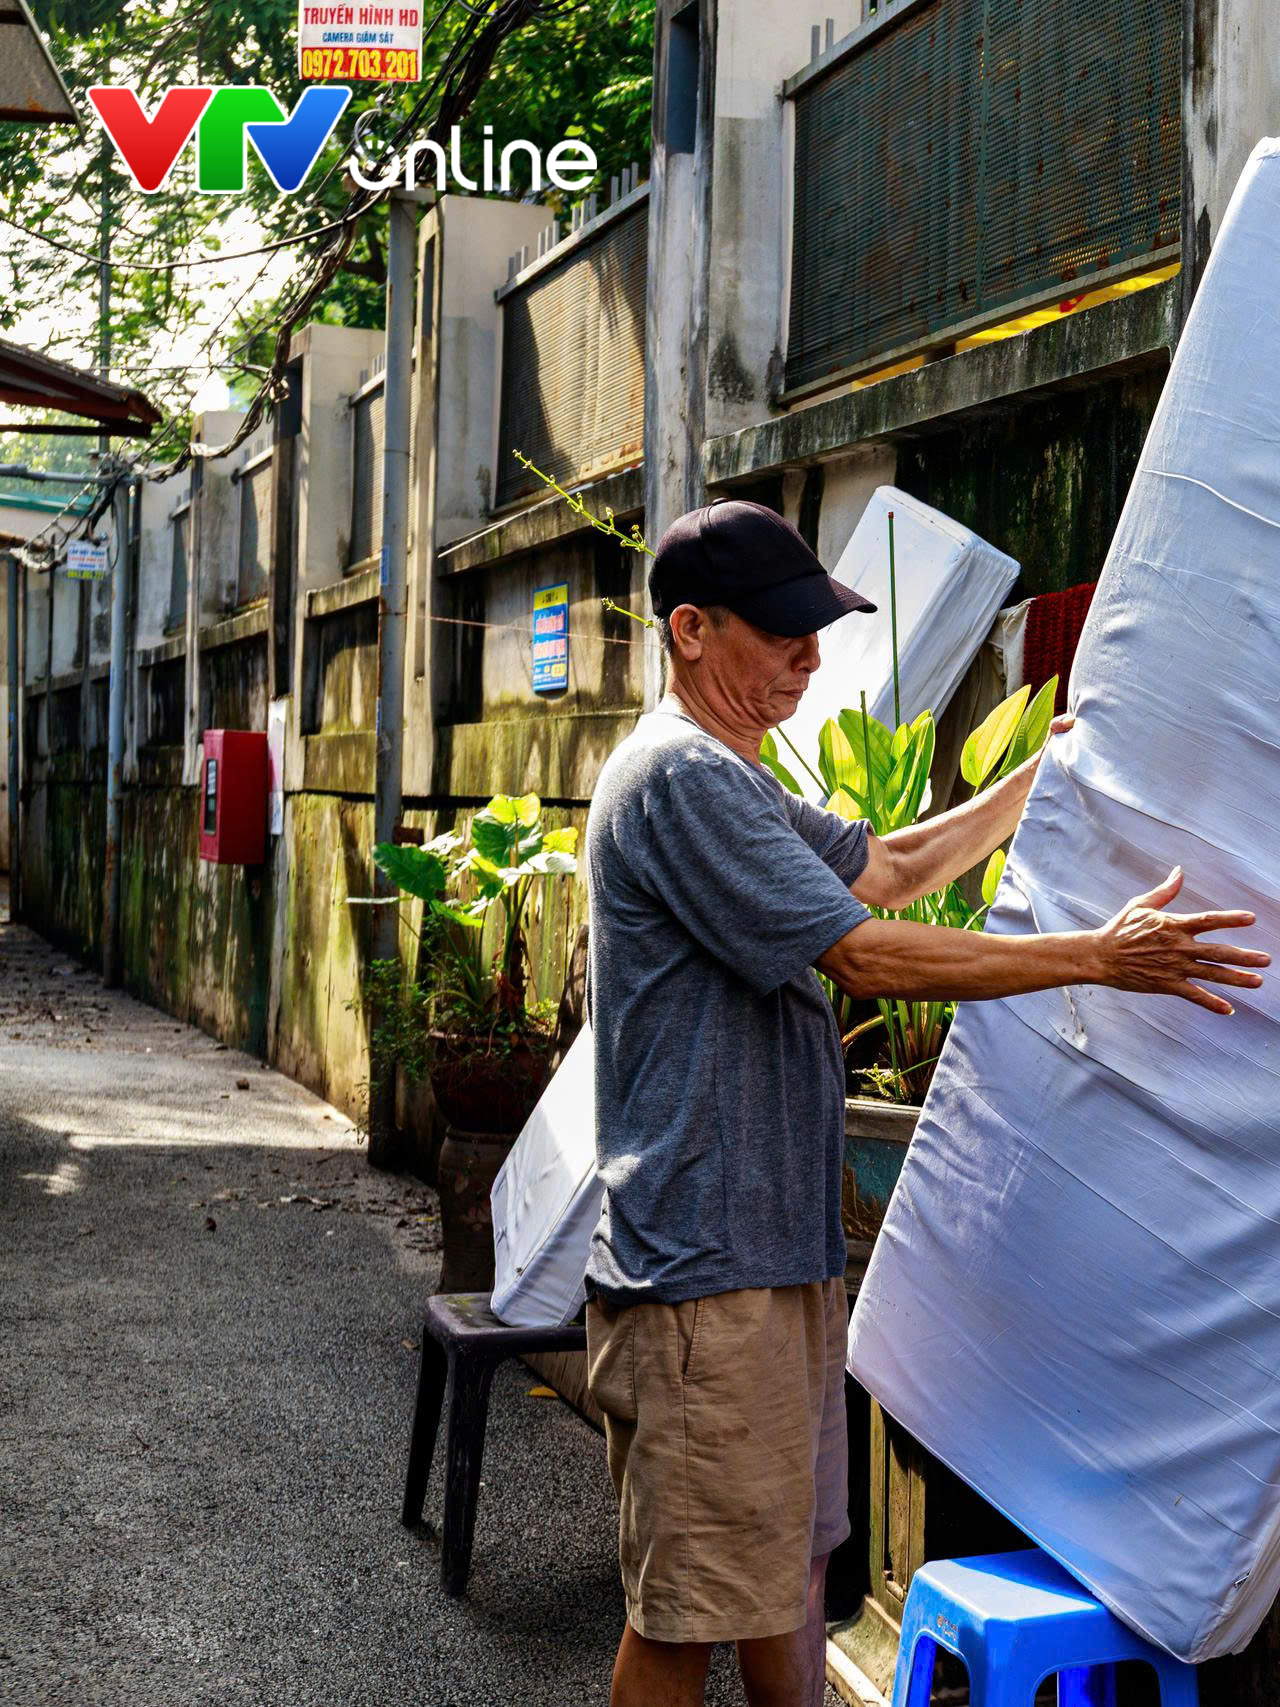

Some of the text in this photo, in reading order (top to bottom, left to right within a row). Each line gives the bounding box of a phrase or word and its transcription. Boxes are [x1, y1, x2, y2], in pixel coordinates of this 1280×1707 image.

[359, 4, 394, 25] HÌNH
[399, 9, 418, 27] HD
[322, 31, 394, 44] CAMERA GIÁM SÁT
[302, 48, 418, 79] 0972.703.201
